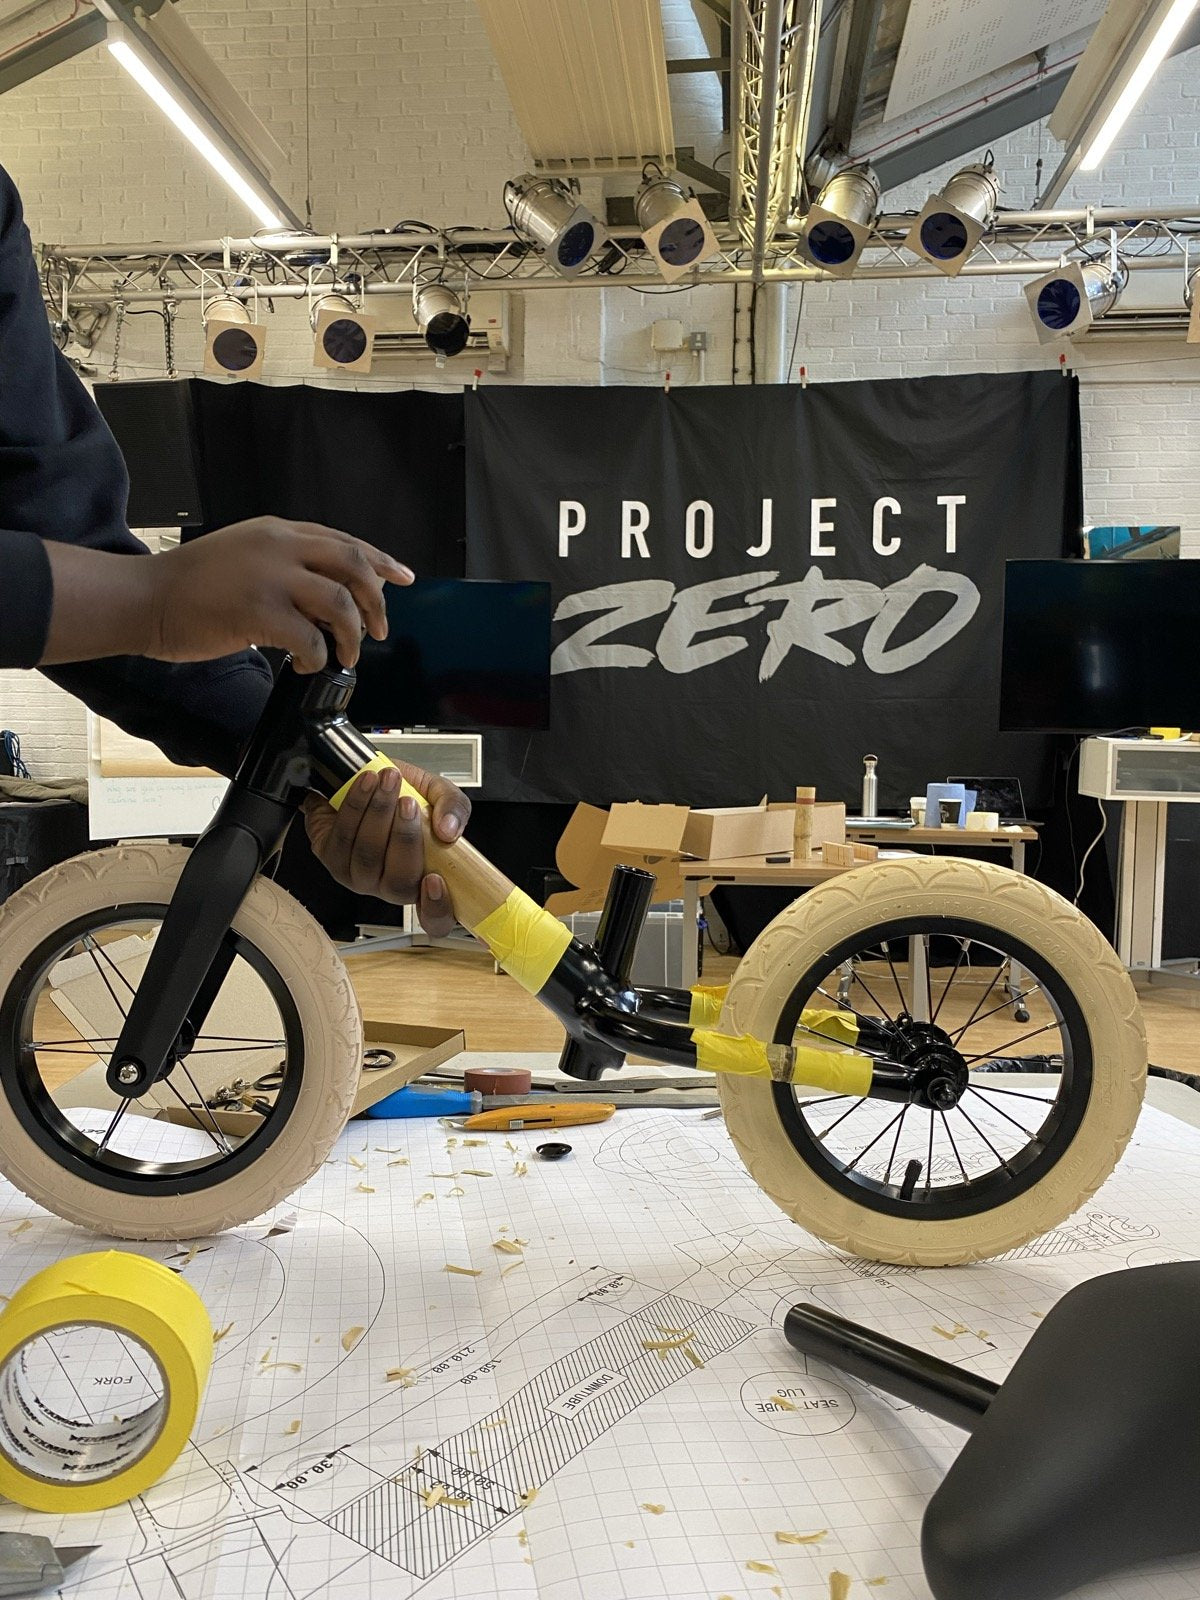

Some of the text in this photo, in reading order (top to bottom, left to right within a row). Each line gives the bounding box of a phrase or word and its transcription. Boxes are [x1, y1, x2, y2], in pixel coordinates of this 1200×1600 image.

[558, 495, 966, 558] PROJECT
[550, 562, 981, 684] ZERO
[432, 1347, 475, 1373] 210.00
[460, 1359, 502, 1384] 150.00
[93, 1376, 133, 1385] FORK
[562, 1374, 614, 1410] DOWNTUBE
[777, 1388, 806, 1398] LUG
[755, 1400, 839, 1412] SEAT UBE
[26, 1430, 79, 1455] FIXMAN
[287, 1460, 333, 1489] 30.00
